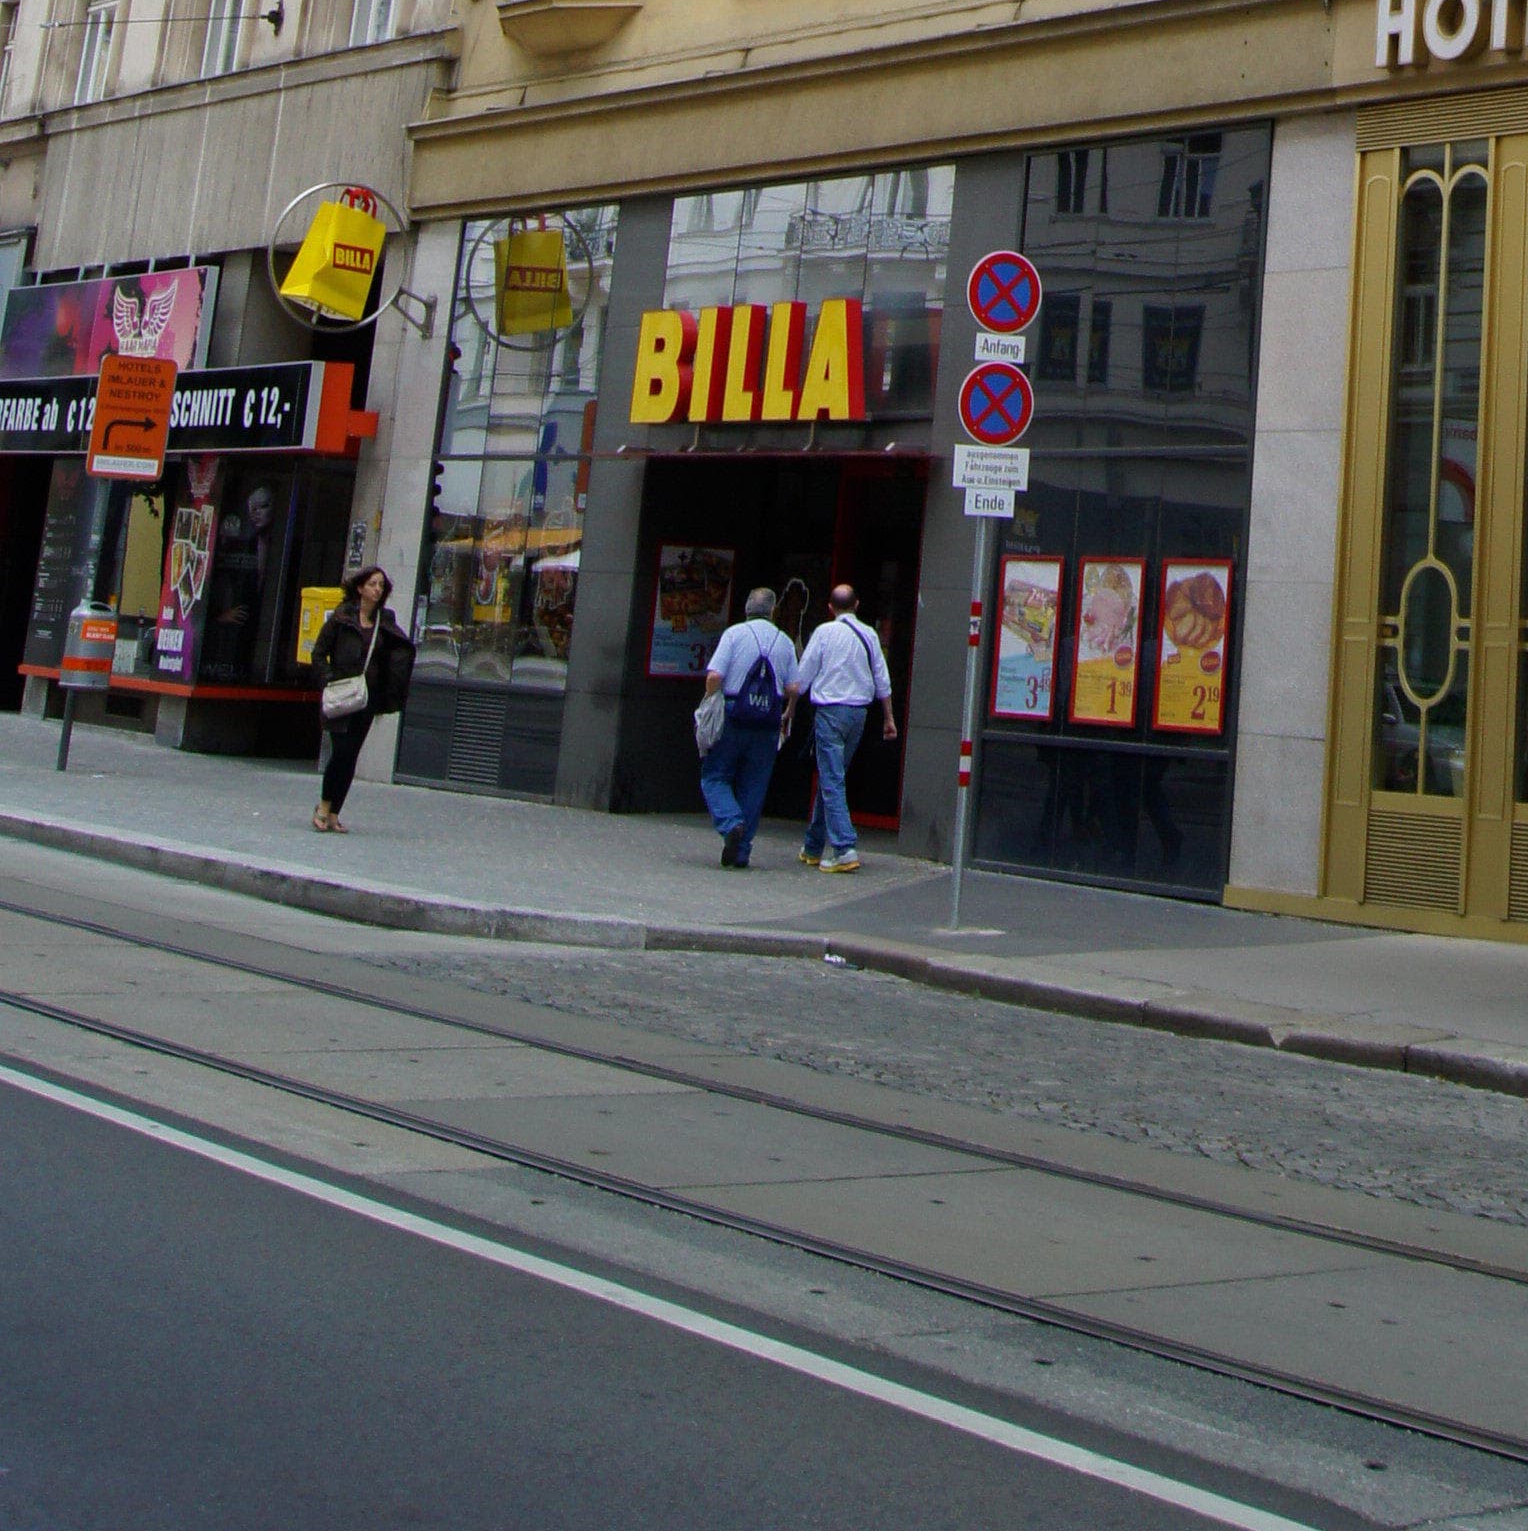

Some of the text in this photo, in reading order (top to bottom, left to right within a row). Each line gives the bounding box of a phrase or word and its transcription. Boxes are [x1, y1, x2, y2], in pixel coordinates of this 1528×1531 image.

[335, 247, 371, 271] BILLA
[981, 337, 1020, 357] Anfang
[118, 362, 162, 373] HOTELS
[630, 298, 863, 424] BILLA
[107, 374, 156, 387] IMLAUER
[109, 388, 160, 401] NESTROY
[41, 397, 59, 431] ab
[170, 388, 236, 428] SCHNITT
[975, 493, 1005, 511] Ende
